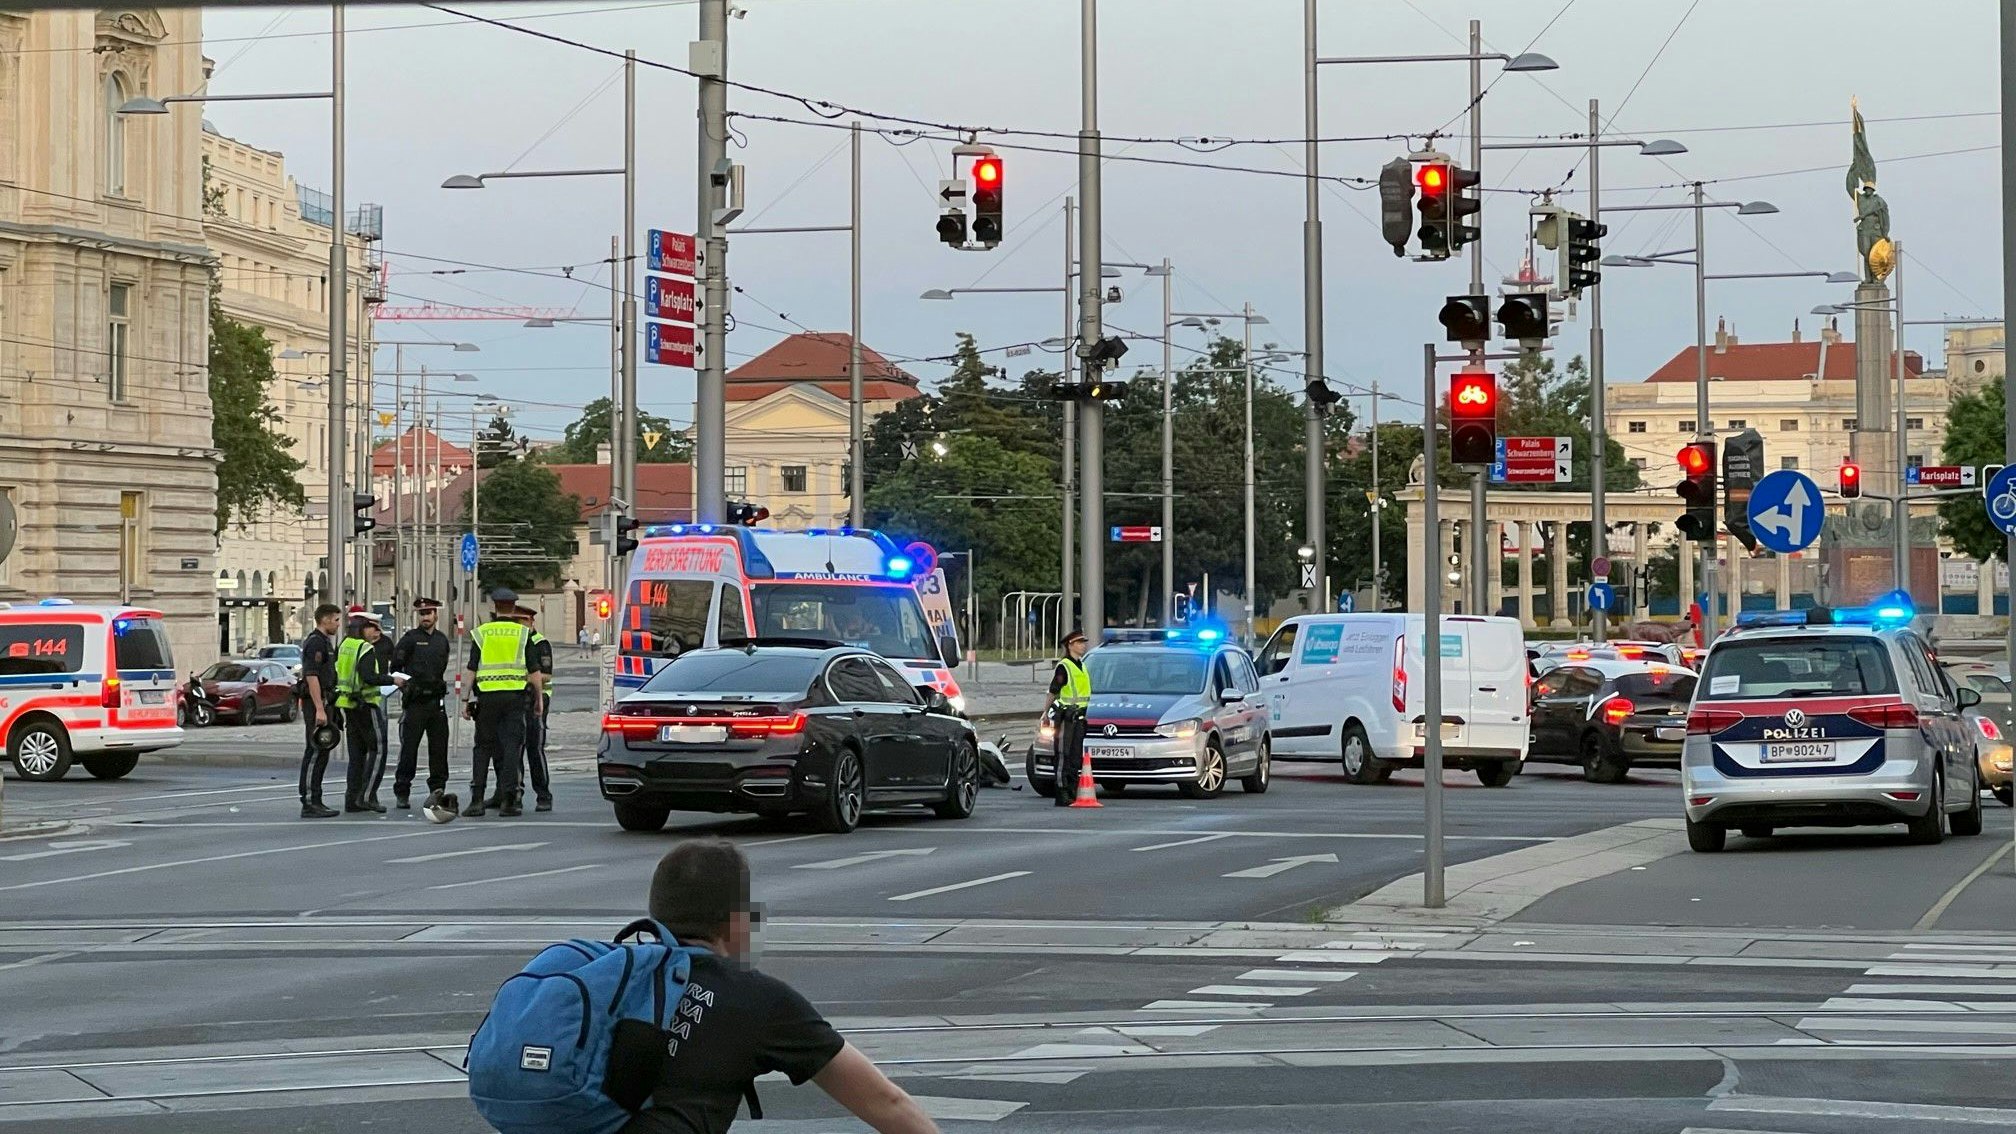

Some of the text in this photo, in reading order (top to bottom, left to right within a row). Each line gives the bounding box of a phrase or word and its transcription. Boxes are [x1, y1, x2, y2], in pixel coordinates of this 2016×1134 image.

[671, 236, 686, 252] Palais
[662, 252, 695, 275] Schwarzenberg
[660, 288, 693, 315] Karlsplatz
[1521, 440, 1541, 448] Palais
[1507, 449, 1555, 459] Schwarzenberg
[1507, 468, 1555, 476] Schwarzenbergplatz
[1921, 471, 1960, 482] Karlsplatz
[643, 547, 725, 573] BERUFSRETTUNG
[794, 572, 872, 582] AMBULANCE
[652, 583, 669, 608] 144
[481, 628, 521, 638] POLIZEI
[33, 638, 67, 656] 144
[1763, 727, 1826, 740] POLIZEI
[1106, 746, 1130, 757] 91254
[1771, 744, 1830, 758] BP 90247
